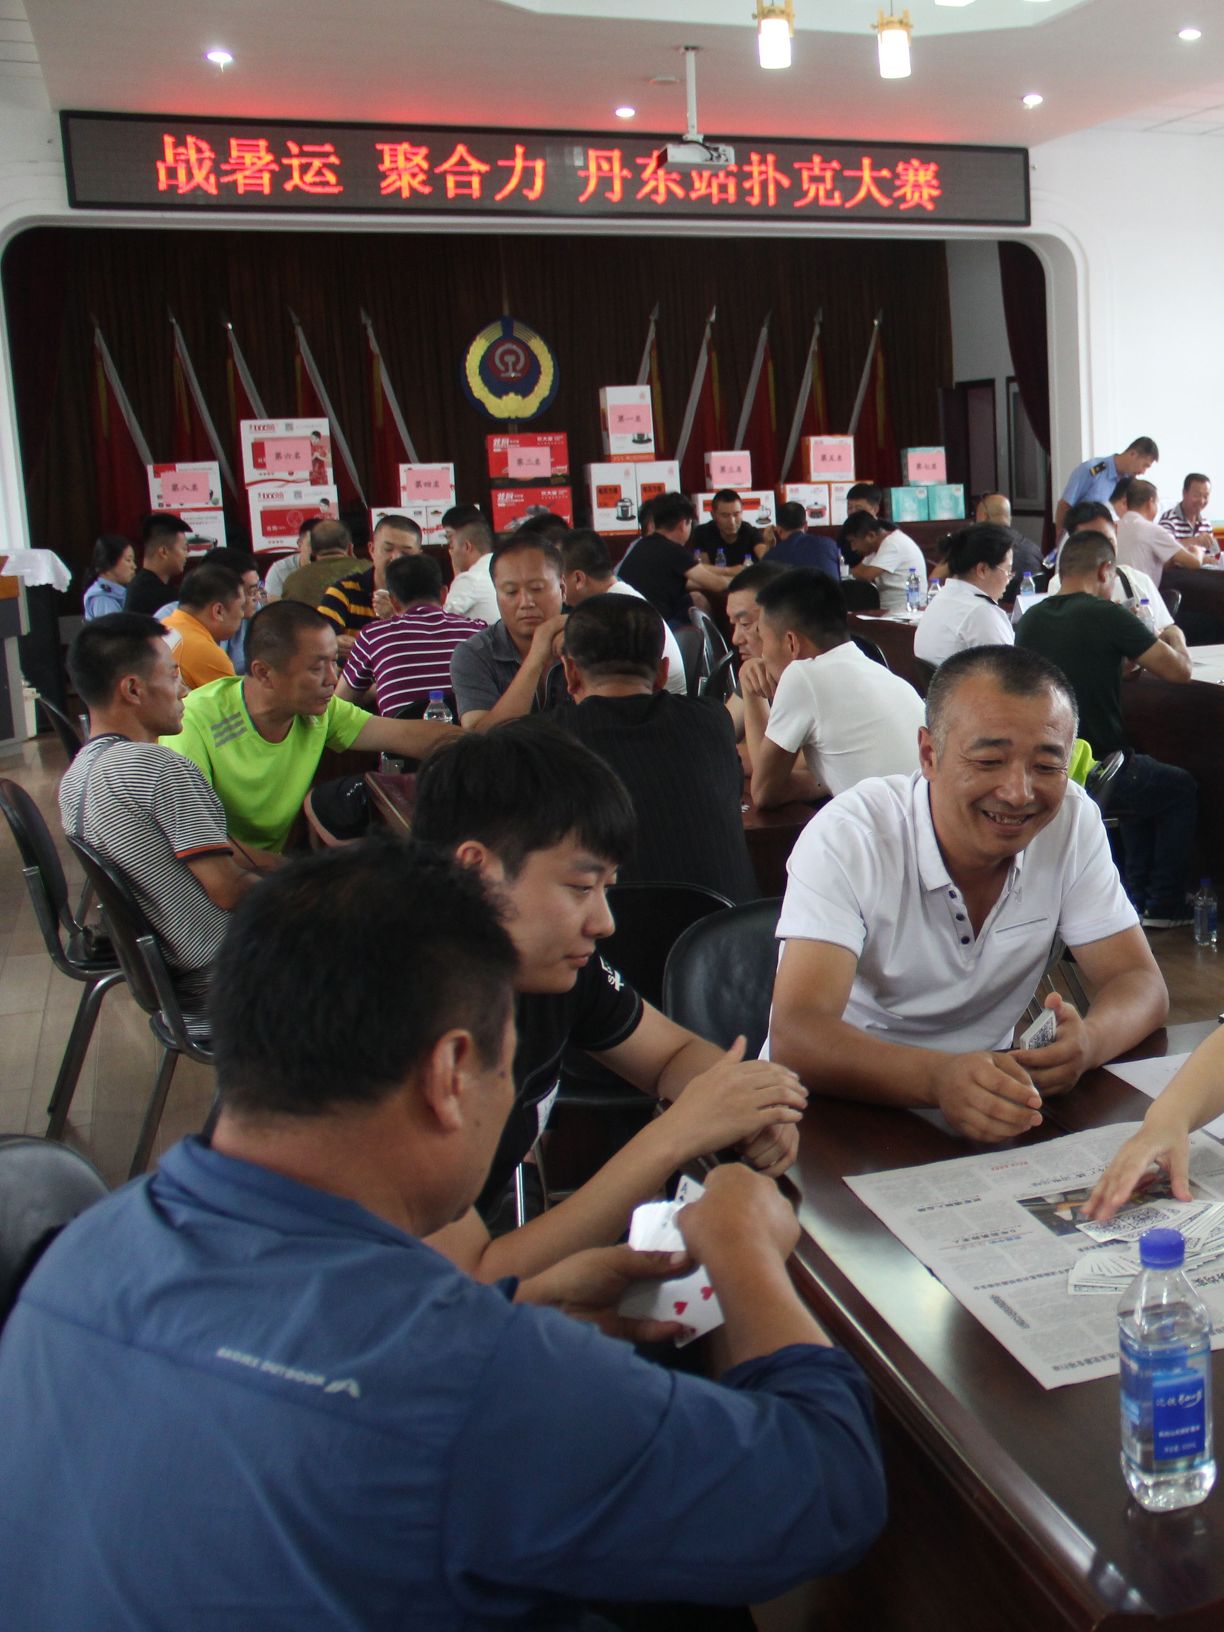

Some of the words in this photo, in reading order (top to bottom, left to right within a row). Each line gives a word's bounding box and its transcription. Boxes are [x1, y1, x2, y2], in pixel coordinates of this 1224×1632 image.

[156, 133, 344, 195] 战暑运
[375, 141, 546, 201] 聚合力
[577, 148, 942, 211] 丹东站扑克大赛
